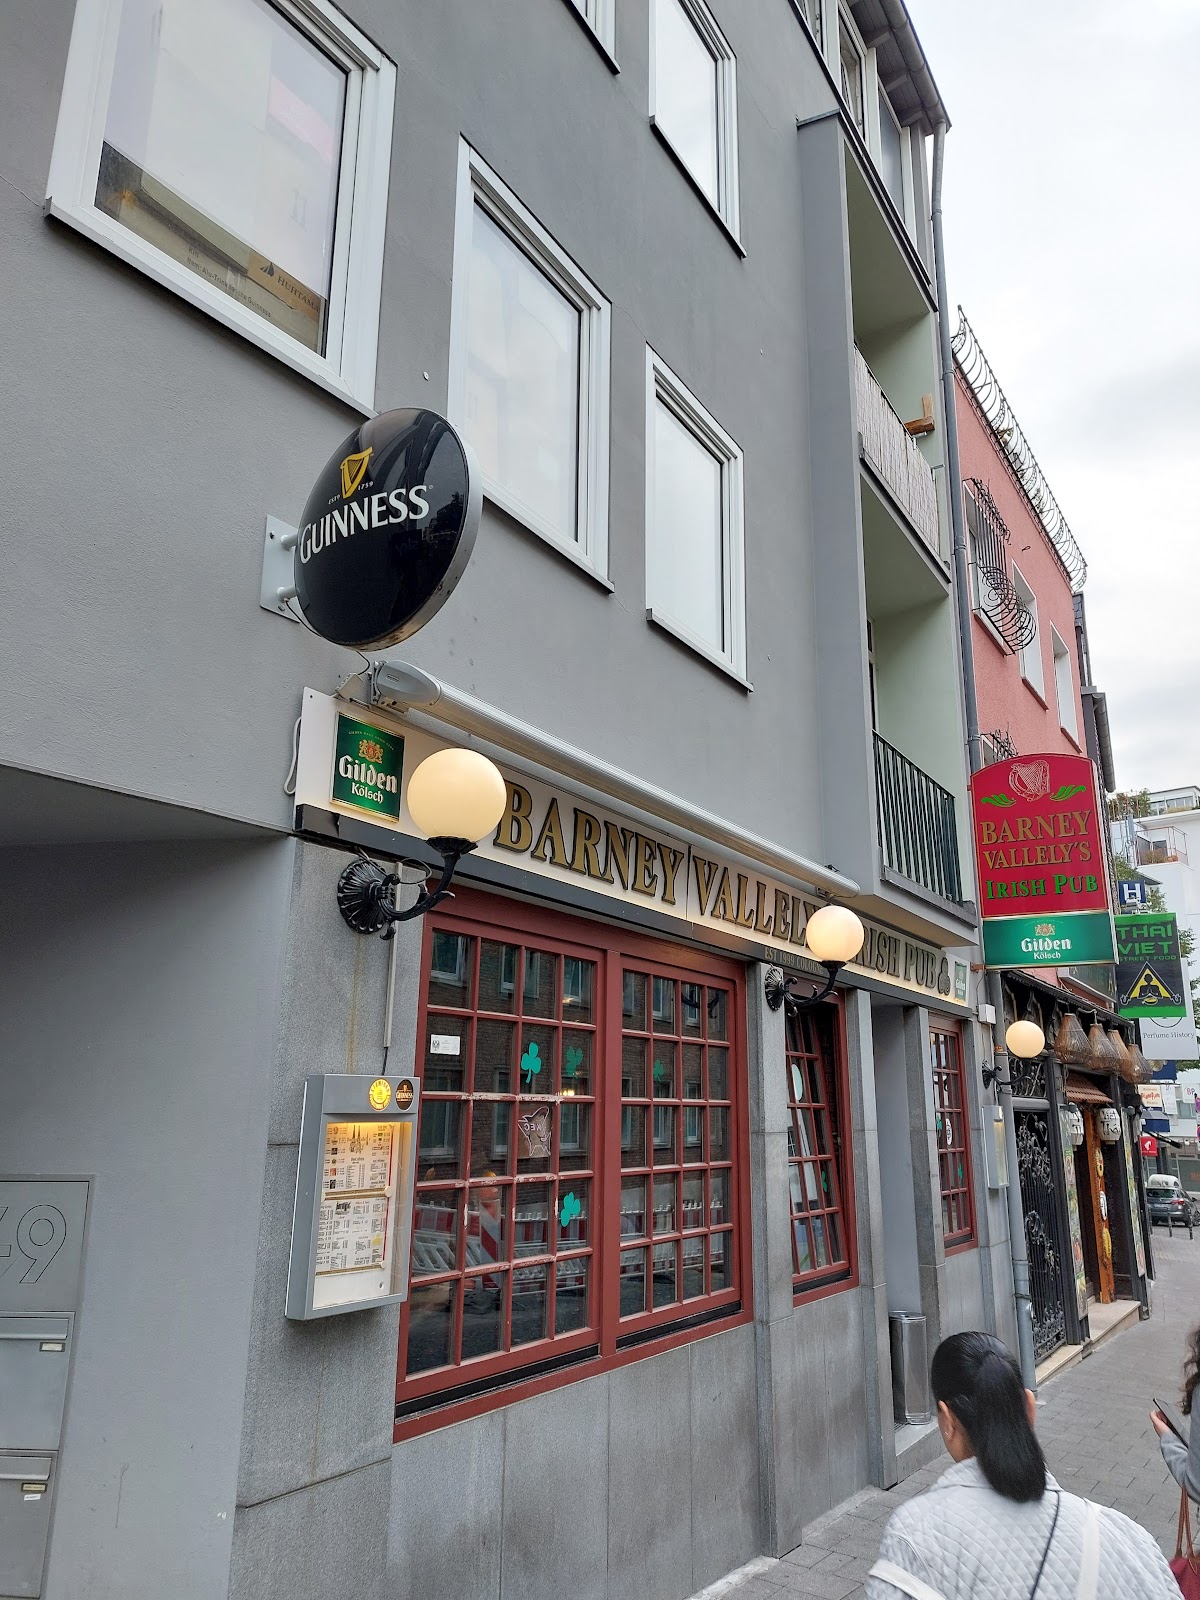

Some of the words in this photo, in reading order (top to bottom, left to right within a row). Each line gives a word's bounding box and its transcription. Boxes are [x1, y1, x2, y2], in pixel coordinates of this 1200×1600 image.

[358, 481, 374, 491] 1759
[300, 485, 430, 564] GUINNESS
[339, 754, 398, 794] Gilden
[351, 781, 384, 804] Kölsch
[980, 810, 1092, 845] BARNEY
[493, 779, 685, 905] BARNEY
[903, 940, 938, 990] PUB
[1123, 883, 1141, 902] H
[1115, 923, 1173, 940] THAI
[1021, 937, 1072, 952] Gilden
[1118, 941, 1173, 955] VIET
[764, 946, 778, 962] EST
[1143, 1031, 1169, 1040] Perfume
[1171, 1030, 1195, 1041] History
